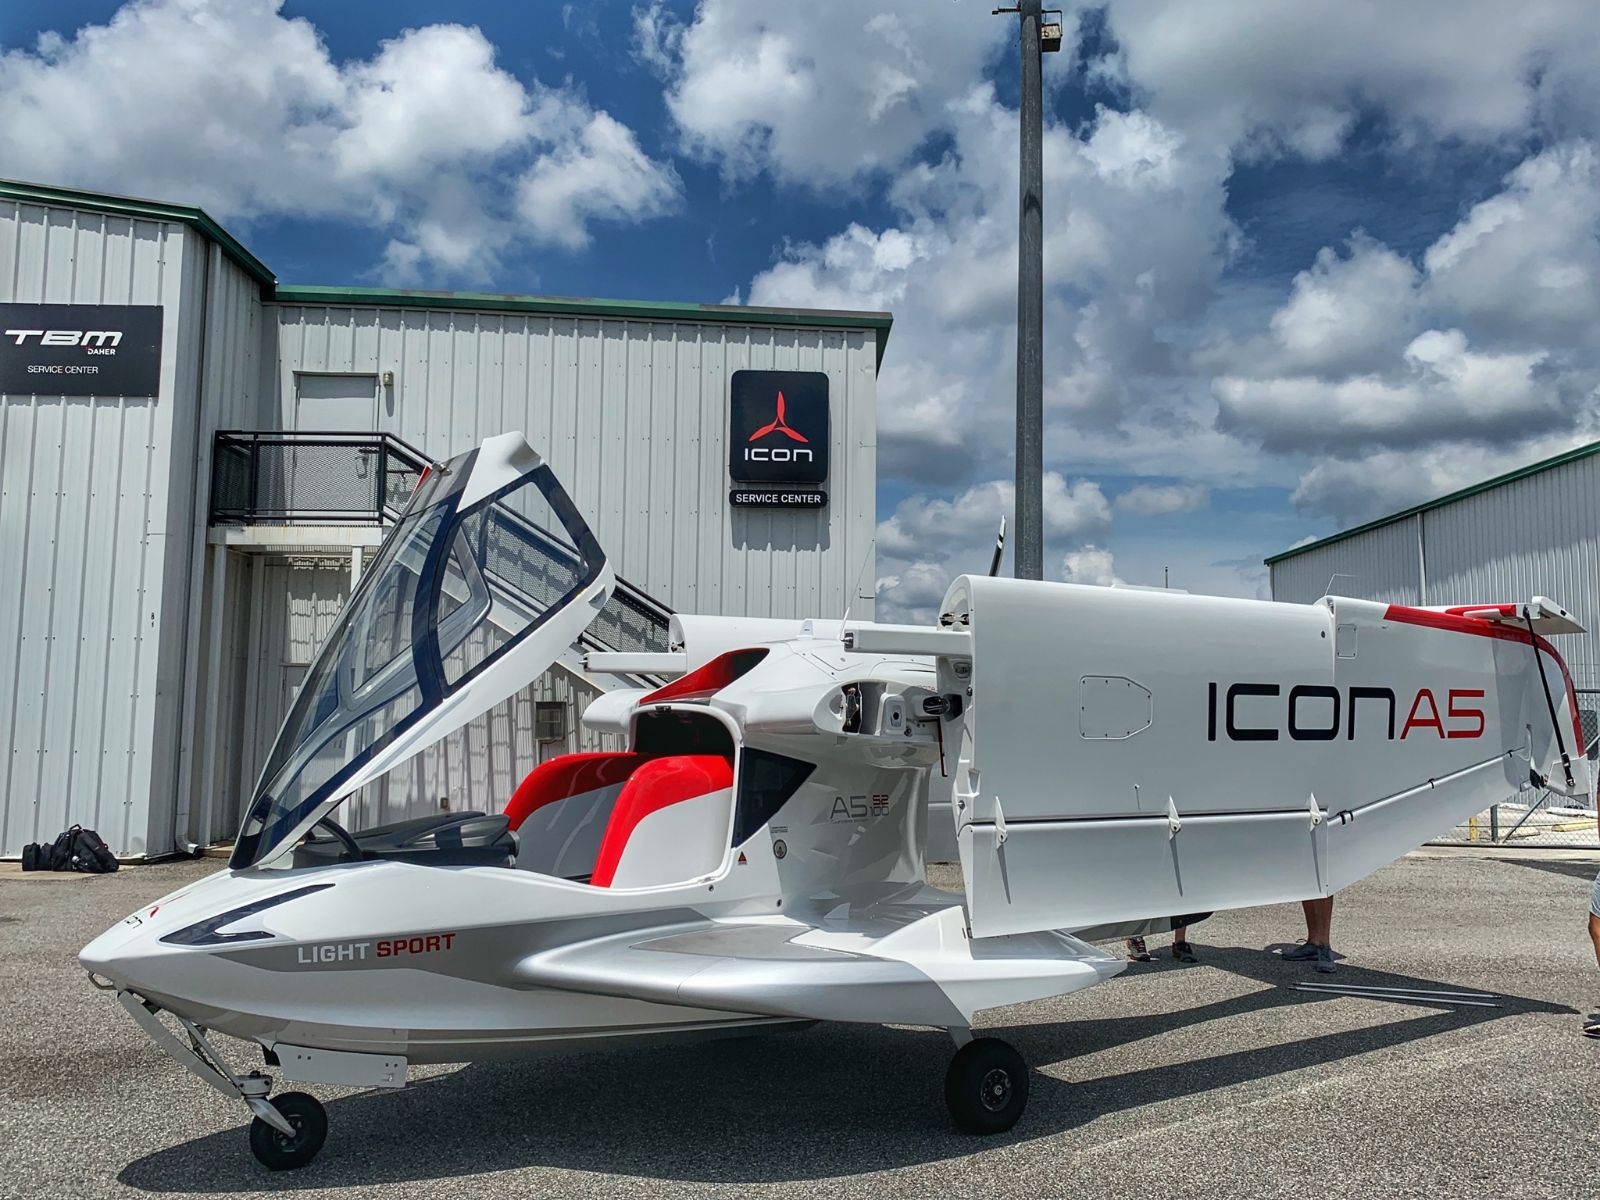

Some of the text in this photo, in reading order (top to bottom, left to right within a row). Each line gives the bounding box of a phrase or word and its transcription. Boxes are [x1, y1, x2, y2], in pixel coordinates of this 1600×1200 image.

[5, 329, 123, 346] TBM
[27, 365, 98, 374] SERVICE CENTER
[736, 493, 821, 503] SERVICE CENTER
[830, 796, 867, 819] A5
[298, 933, 456, 964] LIGHT SPORT
